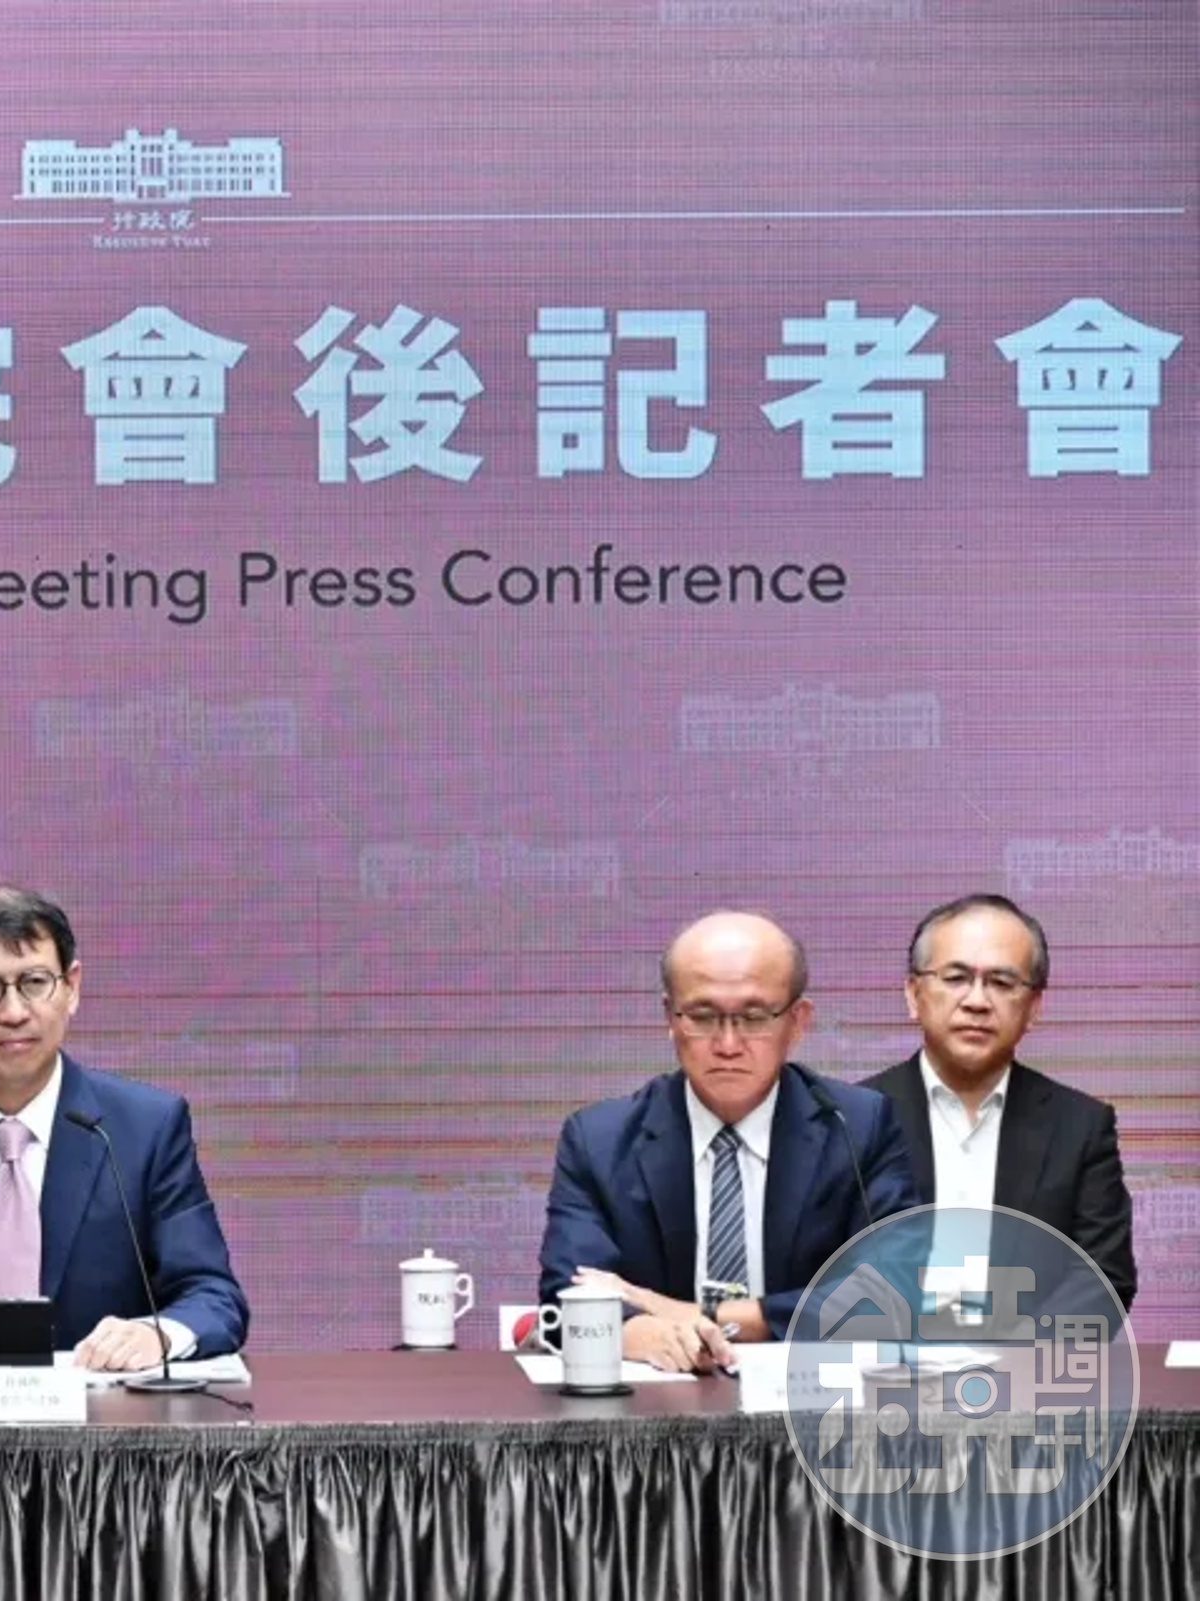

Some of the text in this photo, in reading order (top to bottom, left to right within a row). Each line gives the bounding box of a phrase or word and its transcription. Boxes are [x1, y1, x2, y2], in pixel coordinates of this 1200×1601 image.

[113, 208, 196, 231] 行政院
[239, 551, 416, 607] Press
[441, 543, 847, 606] Conference
